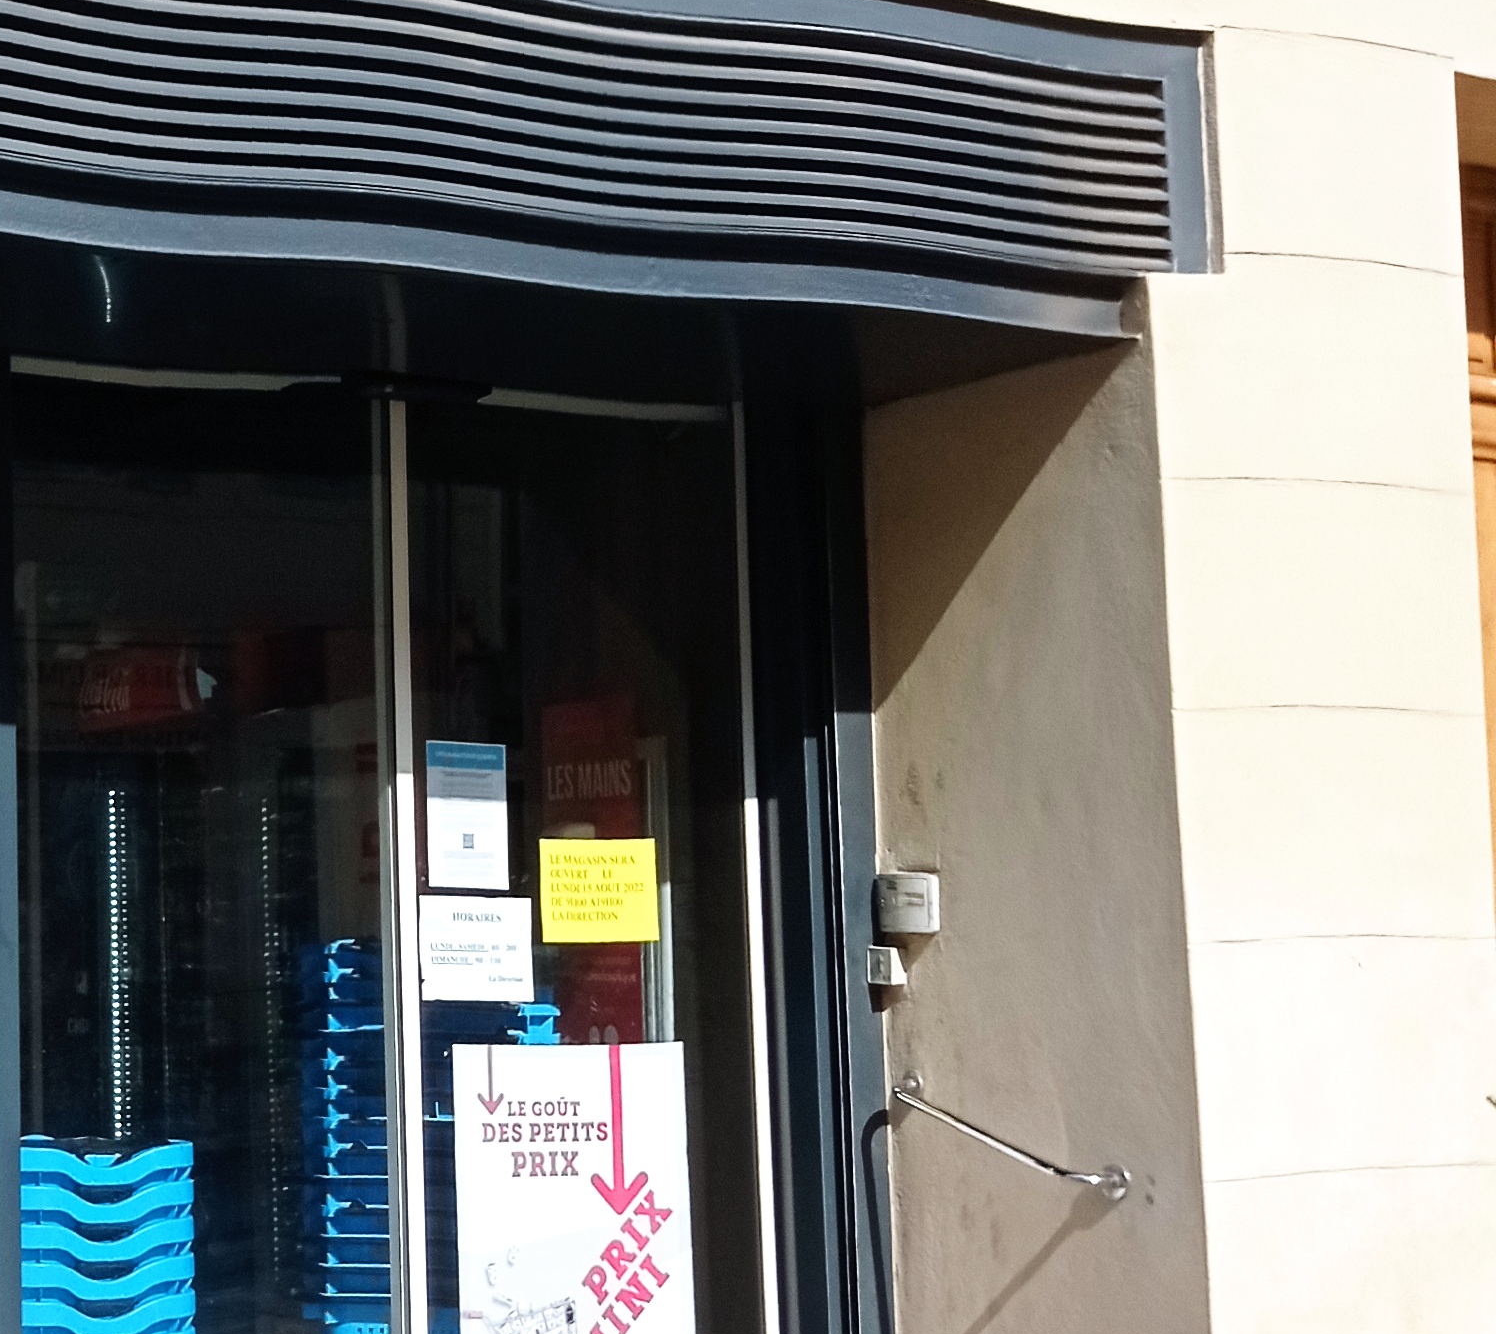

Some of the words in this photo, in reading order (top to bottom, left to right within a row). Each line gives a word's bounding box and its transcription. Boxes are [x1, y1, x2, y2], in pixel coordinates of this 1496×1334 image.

[578, 759, 631, 799] MAINS
[563, 854, 607, 865] MAGASIN
[452, 912, 502, 923] HORAIRES
[507, 1100, 527, 1117] LE
[531, 1096, 581, 1118] GOÛT
[481, 1122, 522, 1143] DES
[528, 1120, 609, 1143] PETITS
[511, 1150, 580, 1178] PRIX
[581, 1189, 673, 1307] PRIX
